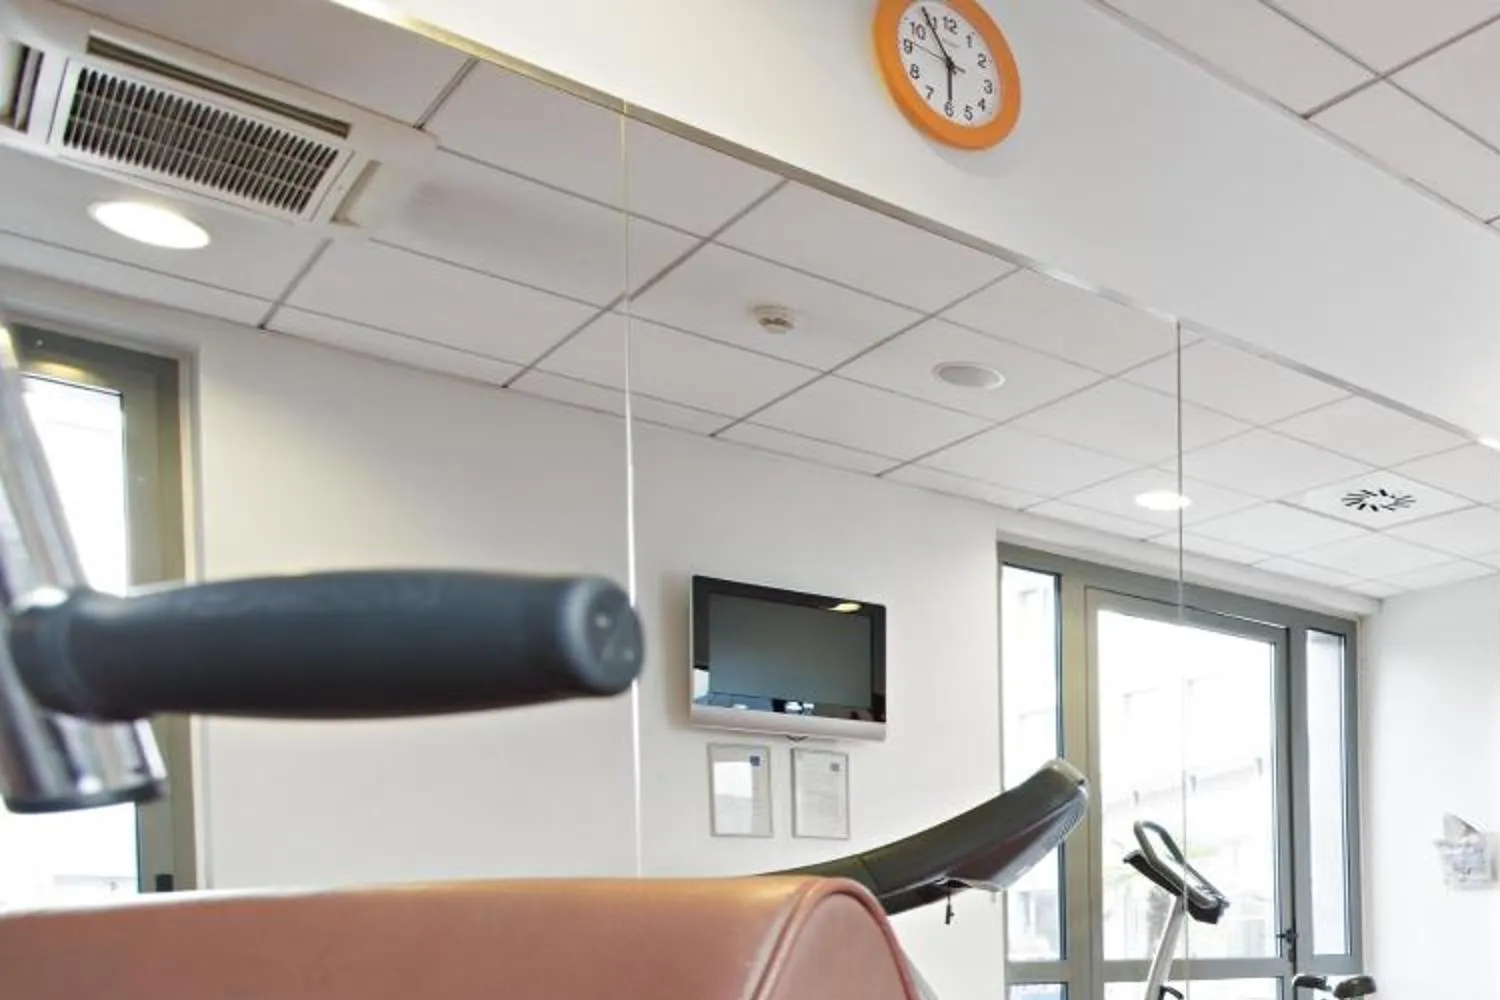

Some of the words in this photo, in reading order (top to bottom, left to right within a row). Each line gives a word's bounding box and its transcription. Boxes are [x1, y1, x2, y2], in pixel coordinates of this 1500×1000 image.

[910, 22, 926, 40] 10
[943, 16, 958, 35] 12
[903, 38, 913, 54] 9
[966, 35, 973, 48] 1
[977, 53, 988, 68] 2
[910, 64, 920, 79] 8
[926, 85, 934, 99] 7
[984, 79, 993, 94] 3
[944, 101, 954, 117] 6
[978, 98, 986, 112] 4
[964, 105, 973, 121] 5
